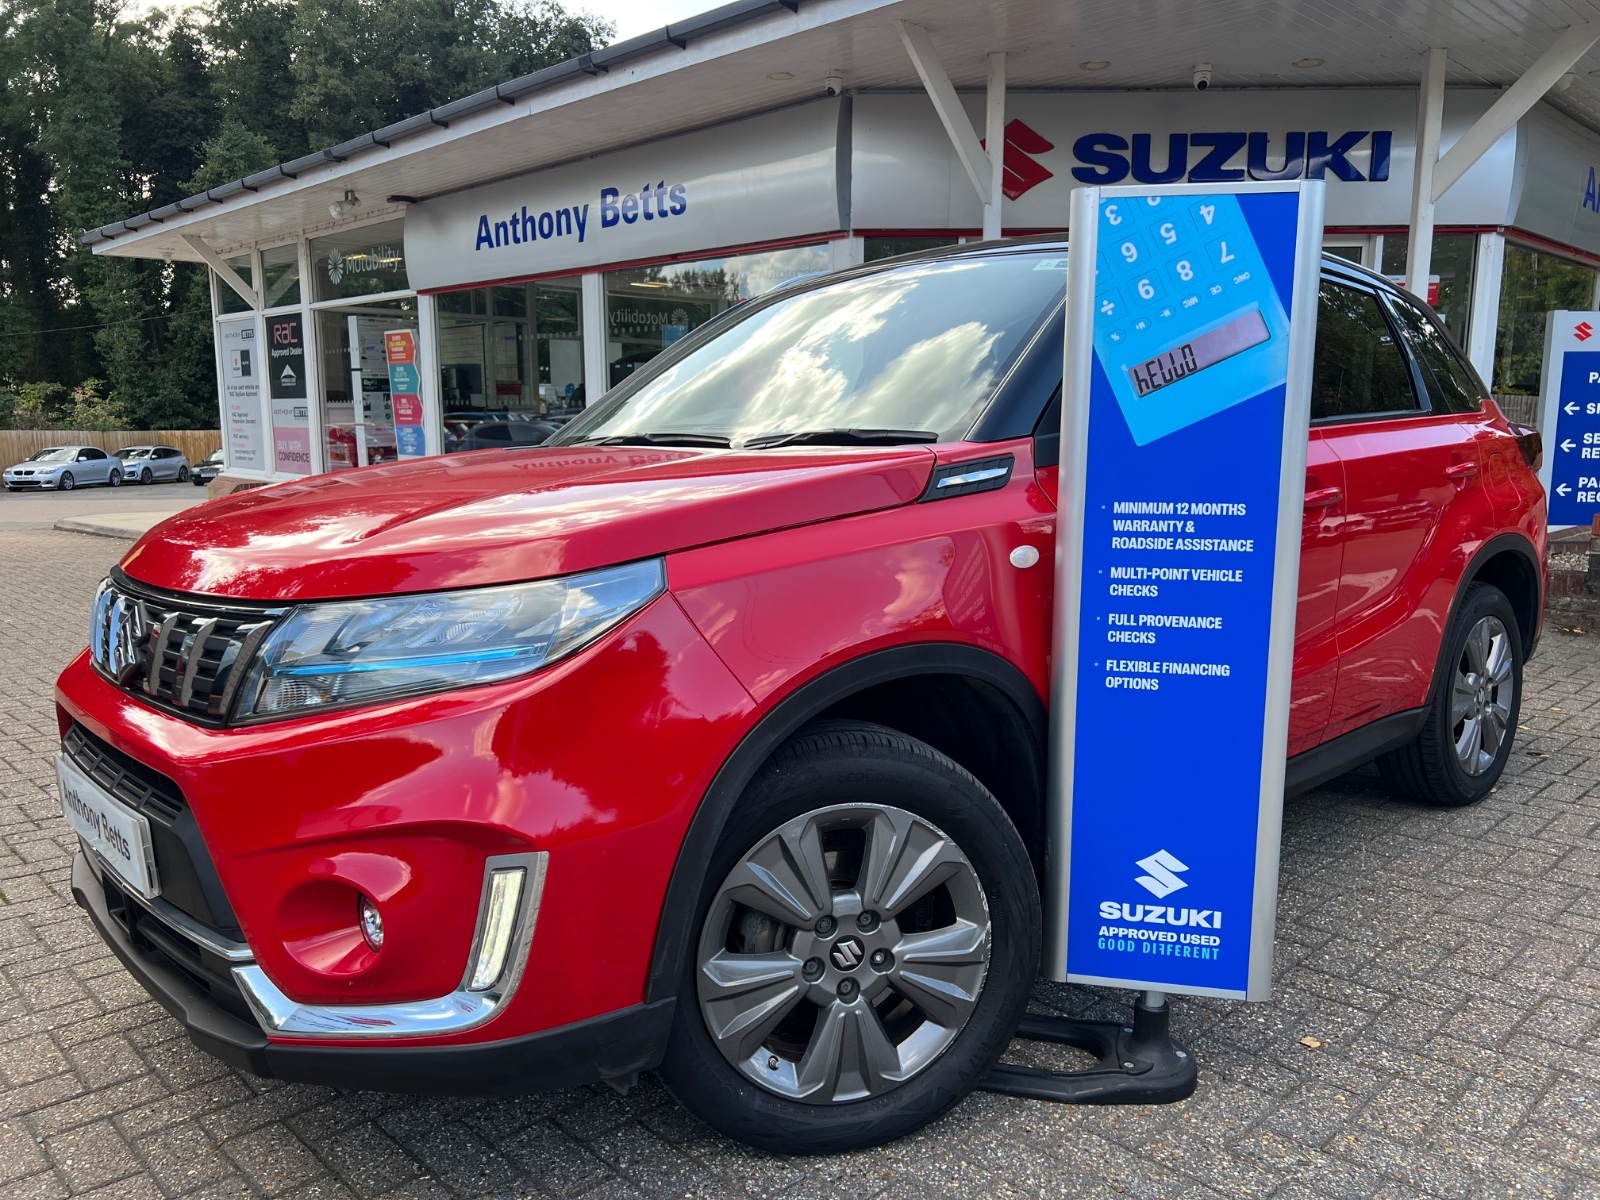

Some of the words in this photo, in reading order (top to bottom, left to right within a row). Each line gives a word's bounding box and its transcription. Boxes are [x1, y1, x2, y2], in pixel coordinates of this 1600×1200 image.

[1071, 130, 1392, 183] SUZUKI
[475, 204, 589, 250] Anthony
[600, 179, 687, 228] Betts
[1105, 204, 1122, 225] 3
[1200, 204, 1215, 225] 4
[1160, 222, 1177, 245] 5
[1219, 241, 1235, 264] 7
[1176, 260, 1193, 282] 8
[271, 347, 289, 358] Approved
[290, 346, 303, 355] Dealer
[1588, 371, 1600, 384] P
[278, 451, 310, 462] CONFIDENCE
[1578, 476, 1600, 488] PA
[1113, 501, 1174, 514] MINIMUM
[1175, 502, 1189, 515] 12
[1190, 503, 1247, 516] MONTHS
[1113, 519, 1184, 532] WARRANTY
[1185, 521, 1195, 533] &
[1112, 537, 1173, 550] ROADSIDE
[1175, 538, 1254, 552] ASSISTANCE
[1110, 566, 1190, 581] MULTI-POINT
[1191, 569, 1243, 582] VEHICLE
[1109, 584, 1158, 597] CHECKS
[1108, 613, 1138, 626] FULL
[1139, 614, 1223, 629] PROVENANCE
[1107, 630, 1156, 644] CHECKS
[1106, 659, 1160, 674] FLEXIBLE
[1162, 661, 1230, 676] FINANCING
[1105, 676, 1159, 690] OPTIONS
[62, 779, 101, 840] Anthony
[101, 811, 131, 861] Betts
[1099, 901, 1222, 929] SUZUKI
[1099, 925, 1178, 943] APPROVED
[1180, 933, 1221, 946] USED
[1098, 937, 1135, 952] GOOD
[1142, 941, 1220, 960] DIFFERENT
